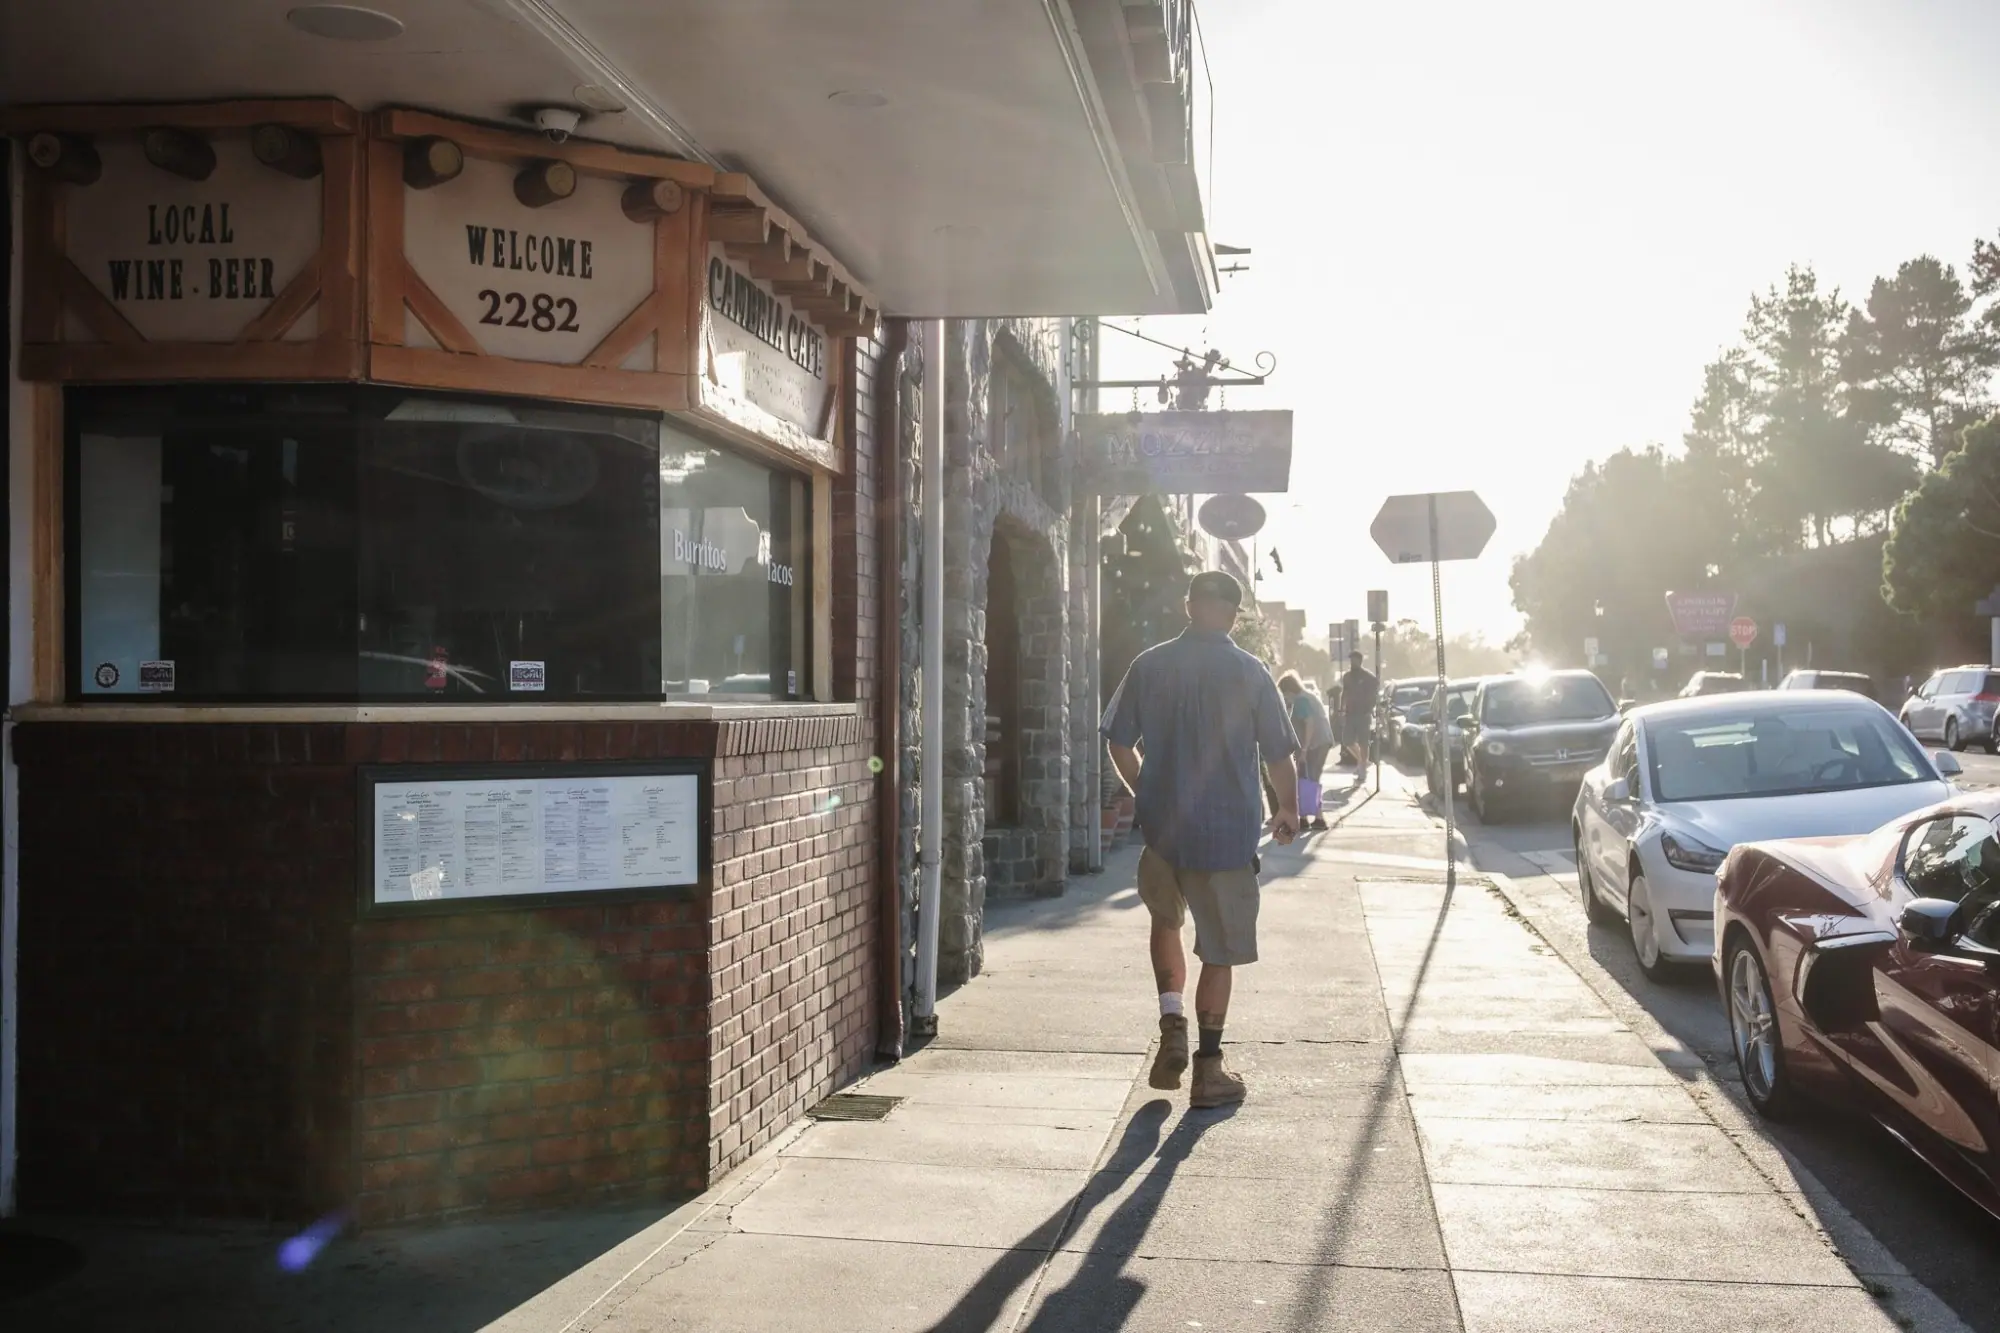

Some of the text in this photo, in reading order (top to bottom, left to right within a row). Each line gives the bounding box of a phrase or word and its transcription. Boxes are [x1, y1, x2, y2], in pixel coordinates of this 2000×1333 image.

[147, 203, 234, 245] LOCAL
[465, 224, 593, 280] WELCOME
[108, 258, 276, 300] WINE BEER
[478, 289, 580, 333] 2282
[708, 256, 823, 380] CAMBRIA CAFE
[673, 528, 726, 571] Burritos
[1732, 625, 1754, 637] STOP
